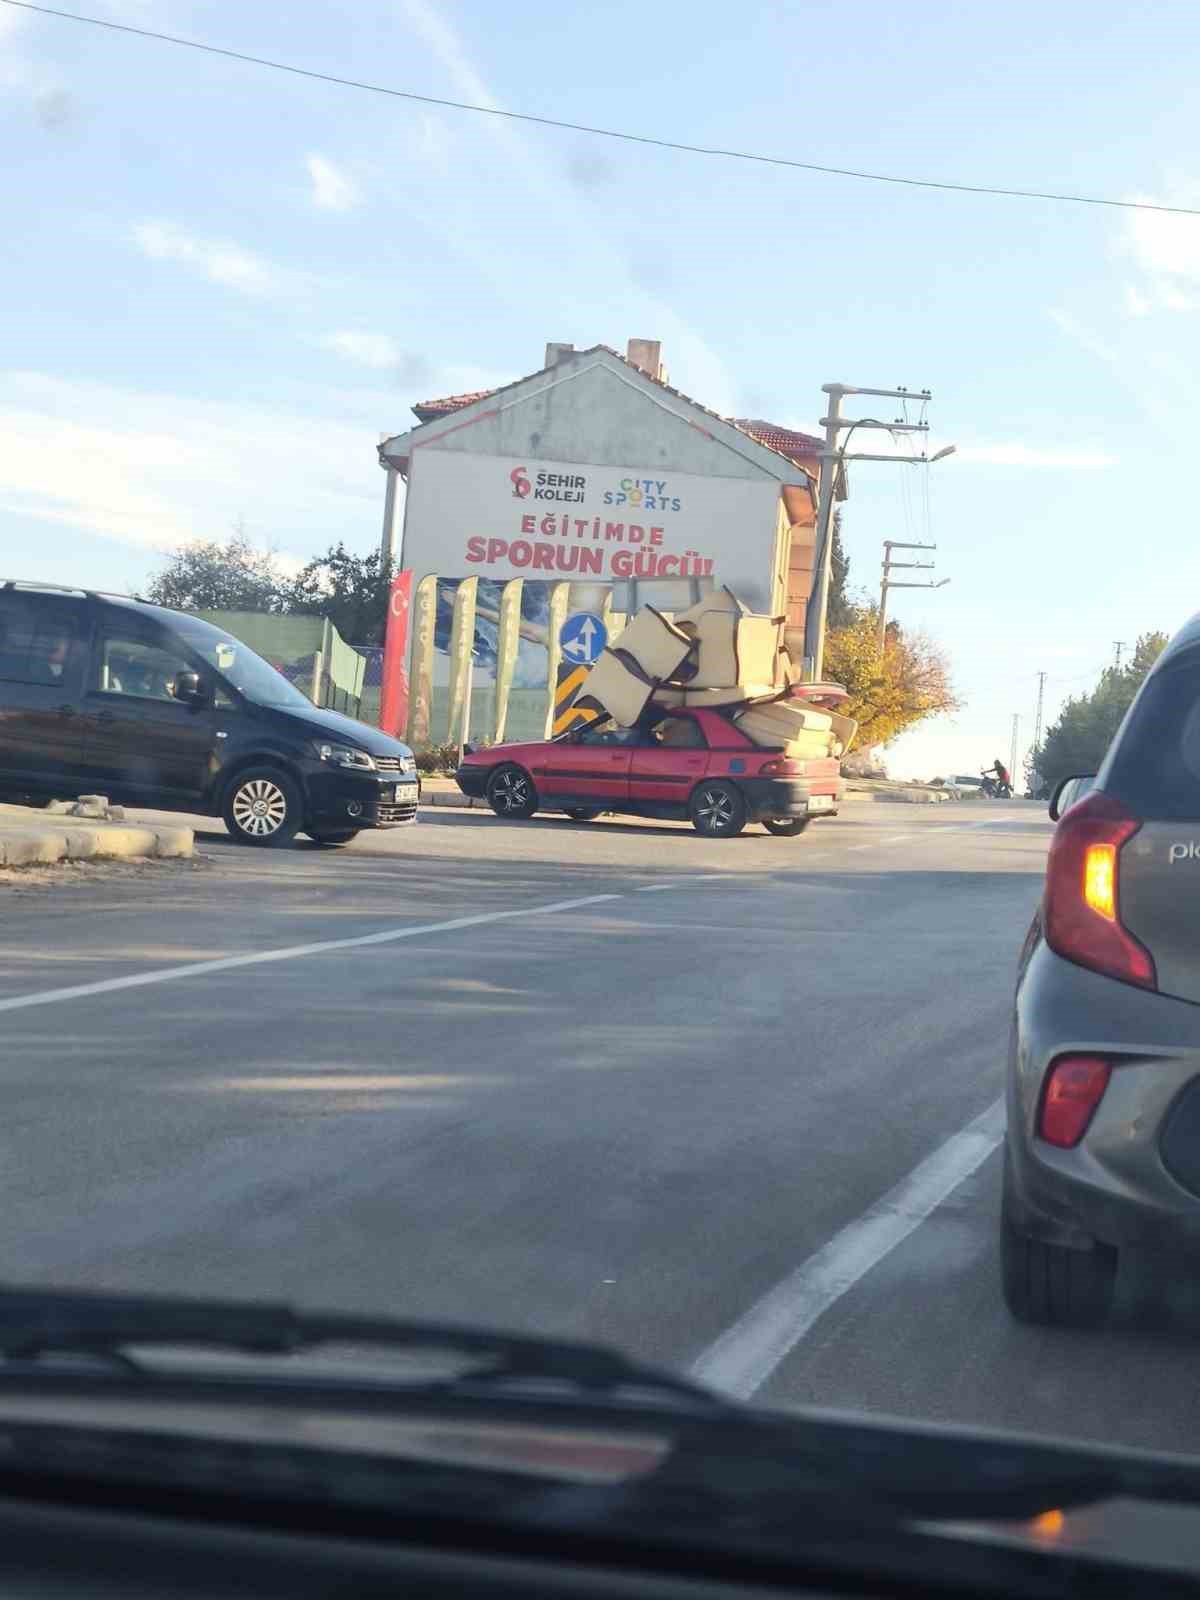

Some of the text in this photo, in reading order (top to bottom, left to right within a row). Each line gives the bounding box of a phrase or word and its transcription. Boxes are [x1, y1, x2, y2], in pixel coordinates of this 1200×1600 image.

[620, 478, 667, 495] CITY
[521, 512, 664, 546] EĞİTİMDE
[465, 536, 603, 574] SPORUN
